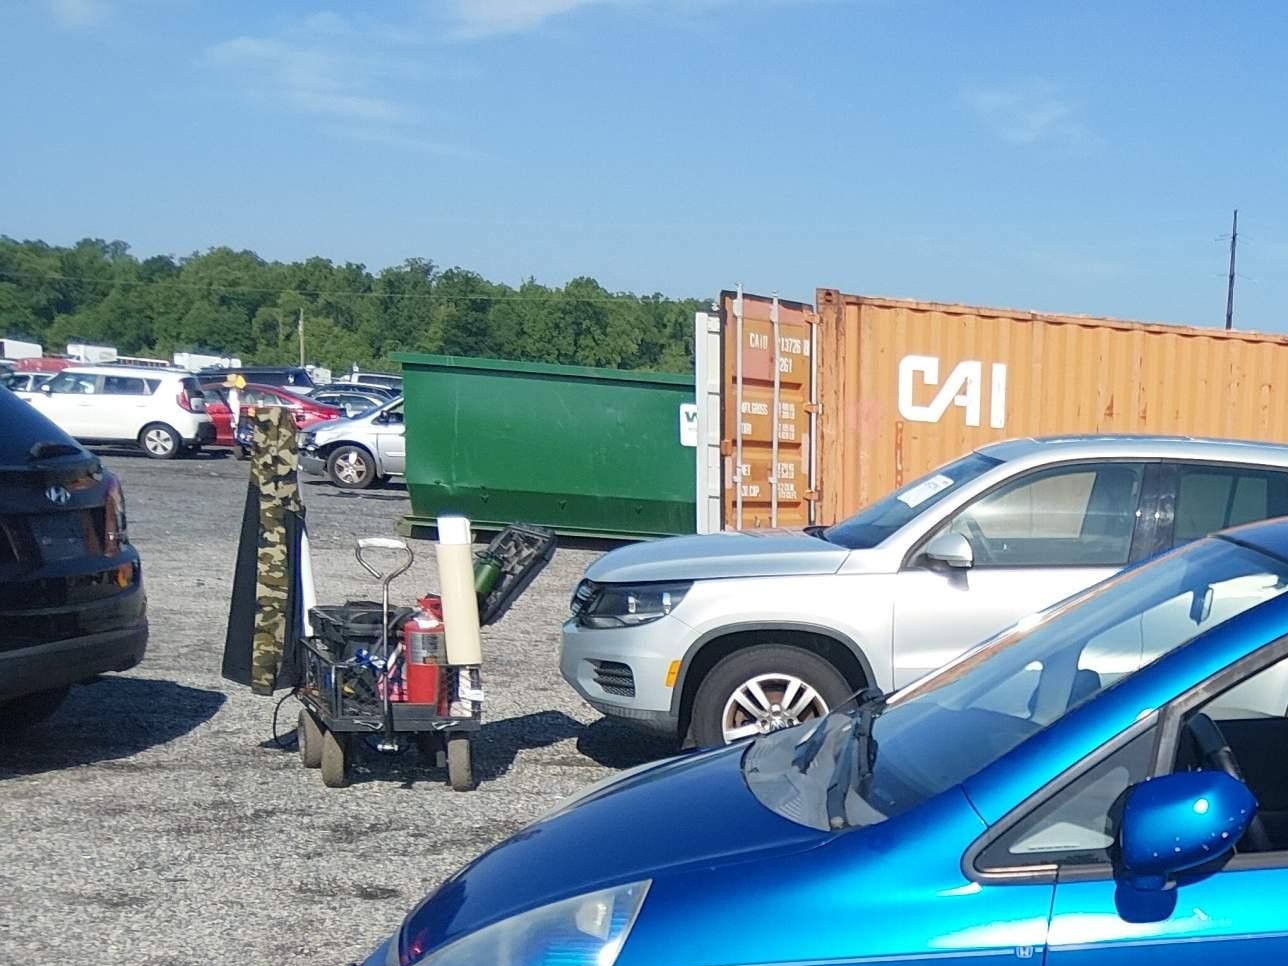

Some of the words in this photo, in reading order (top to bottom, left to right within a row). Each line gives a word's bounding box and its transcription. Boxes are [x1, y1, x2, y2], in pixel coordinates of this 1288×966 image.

[749, 332, 768, 350] CAIU
[779, 336, 801, 354] 13726
[898, 354, 1008, 429] CAI
